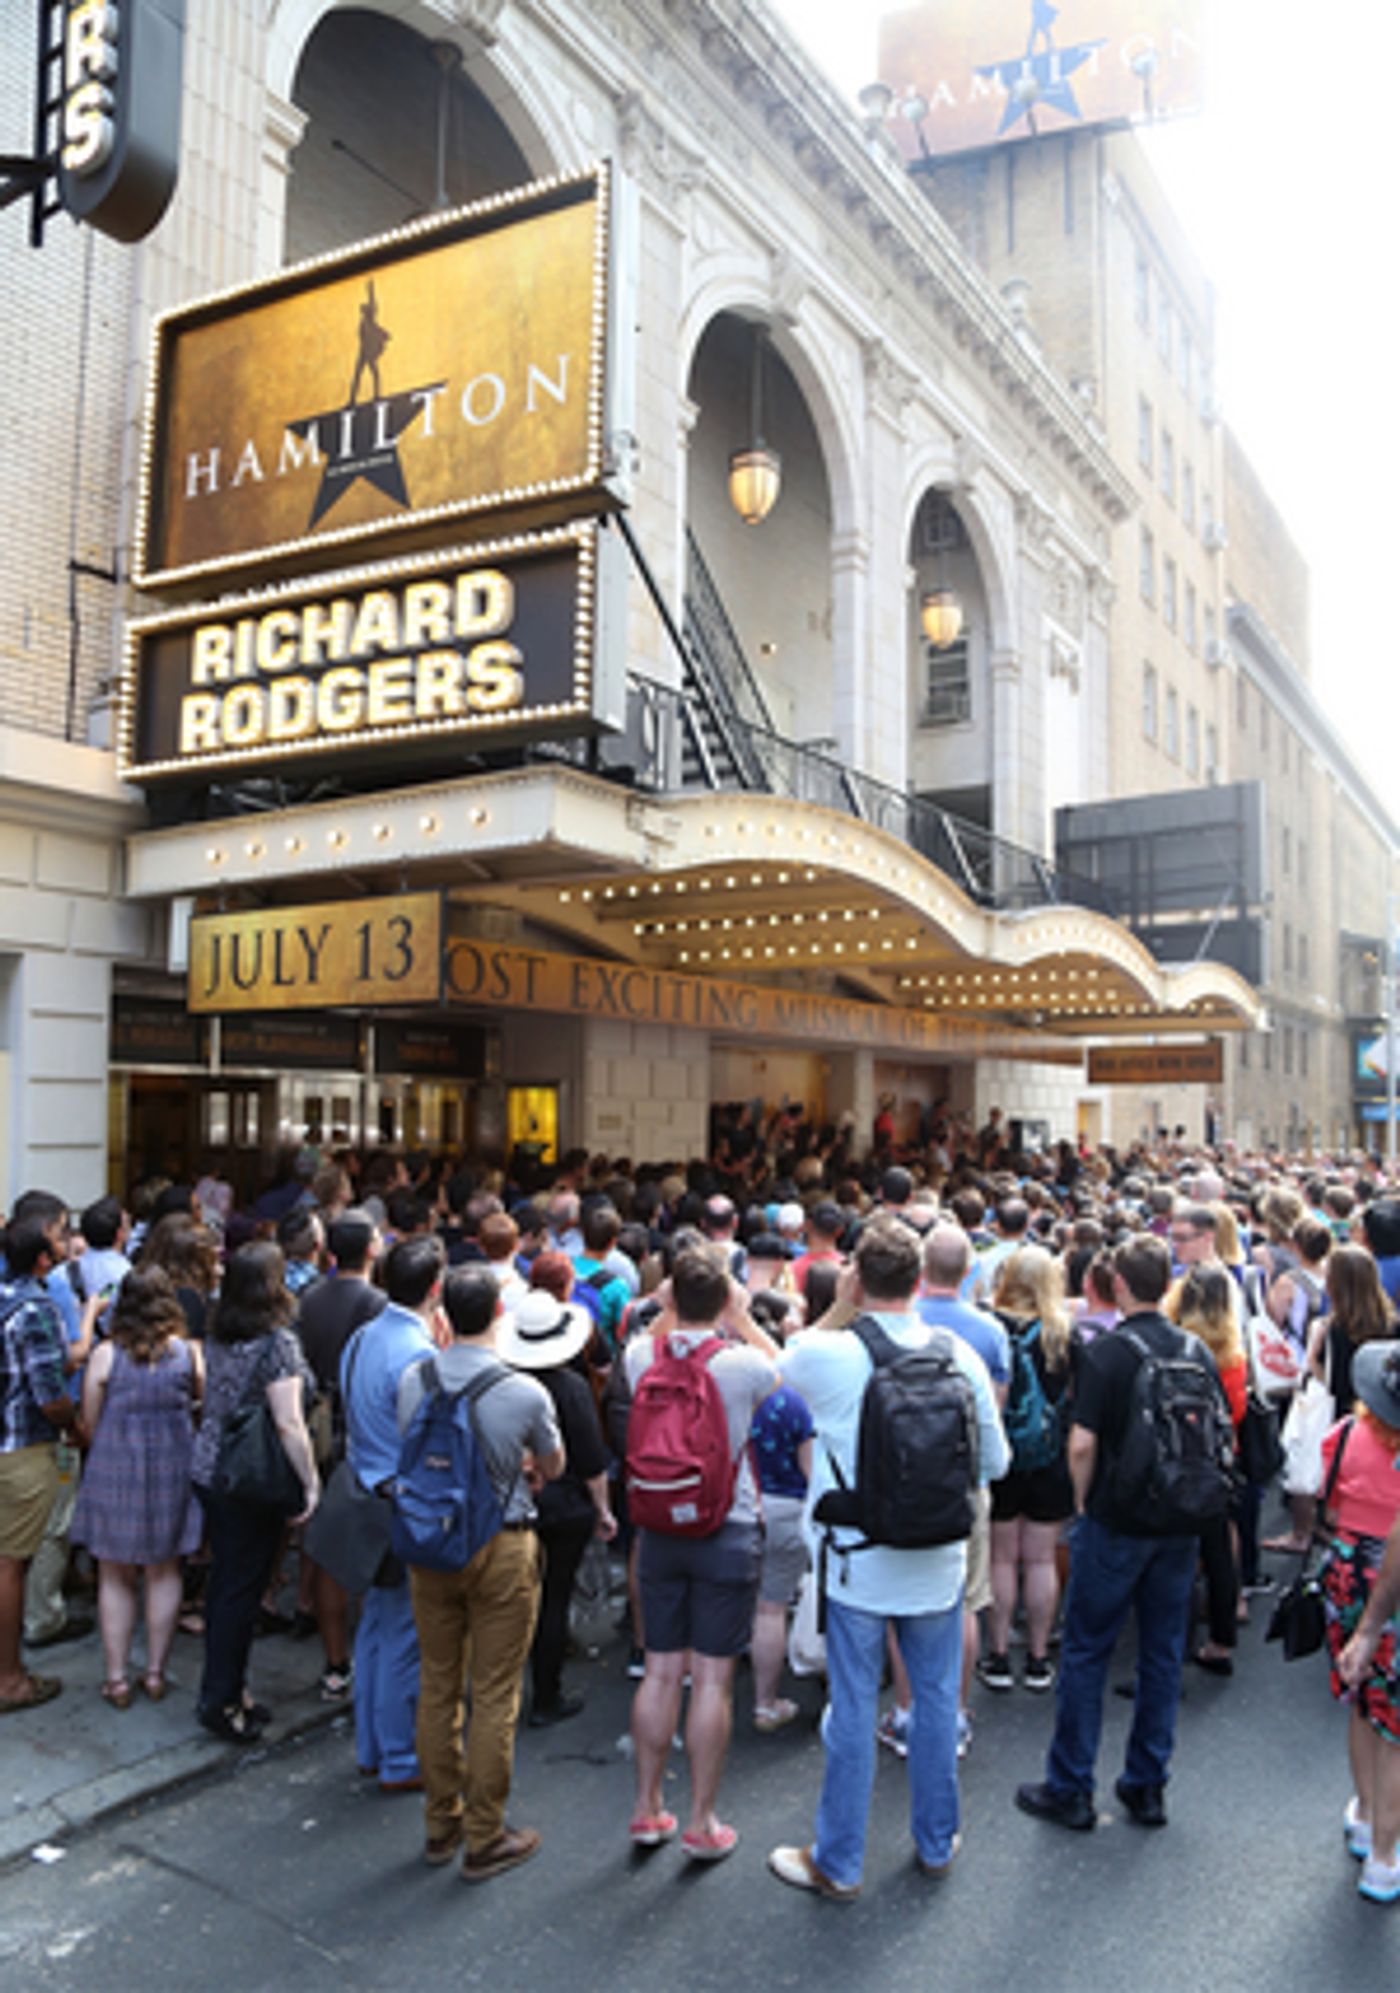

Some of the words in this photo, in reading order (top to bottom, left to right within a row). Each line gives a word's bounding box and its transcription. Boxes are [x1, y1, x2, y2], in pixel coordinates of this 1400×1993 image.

[186, 354, 571, 498] HAMILTON
[191, 568, 515, 686] RICHARD
[179, 638, 525, 754] RODGERS
[205, 922, 332, 998] JULY
[355, 914, 416, 983] 13
[570, 961, 758, 1027] EXCITING
